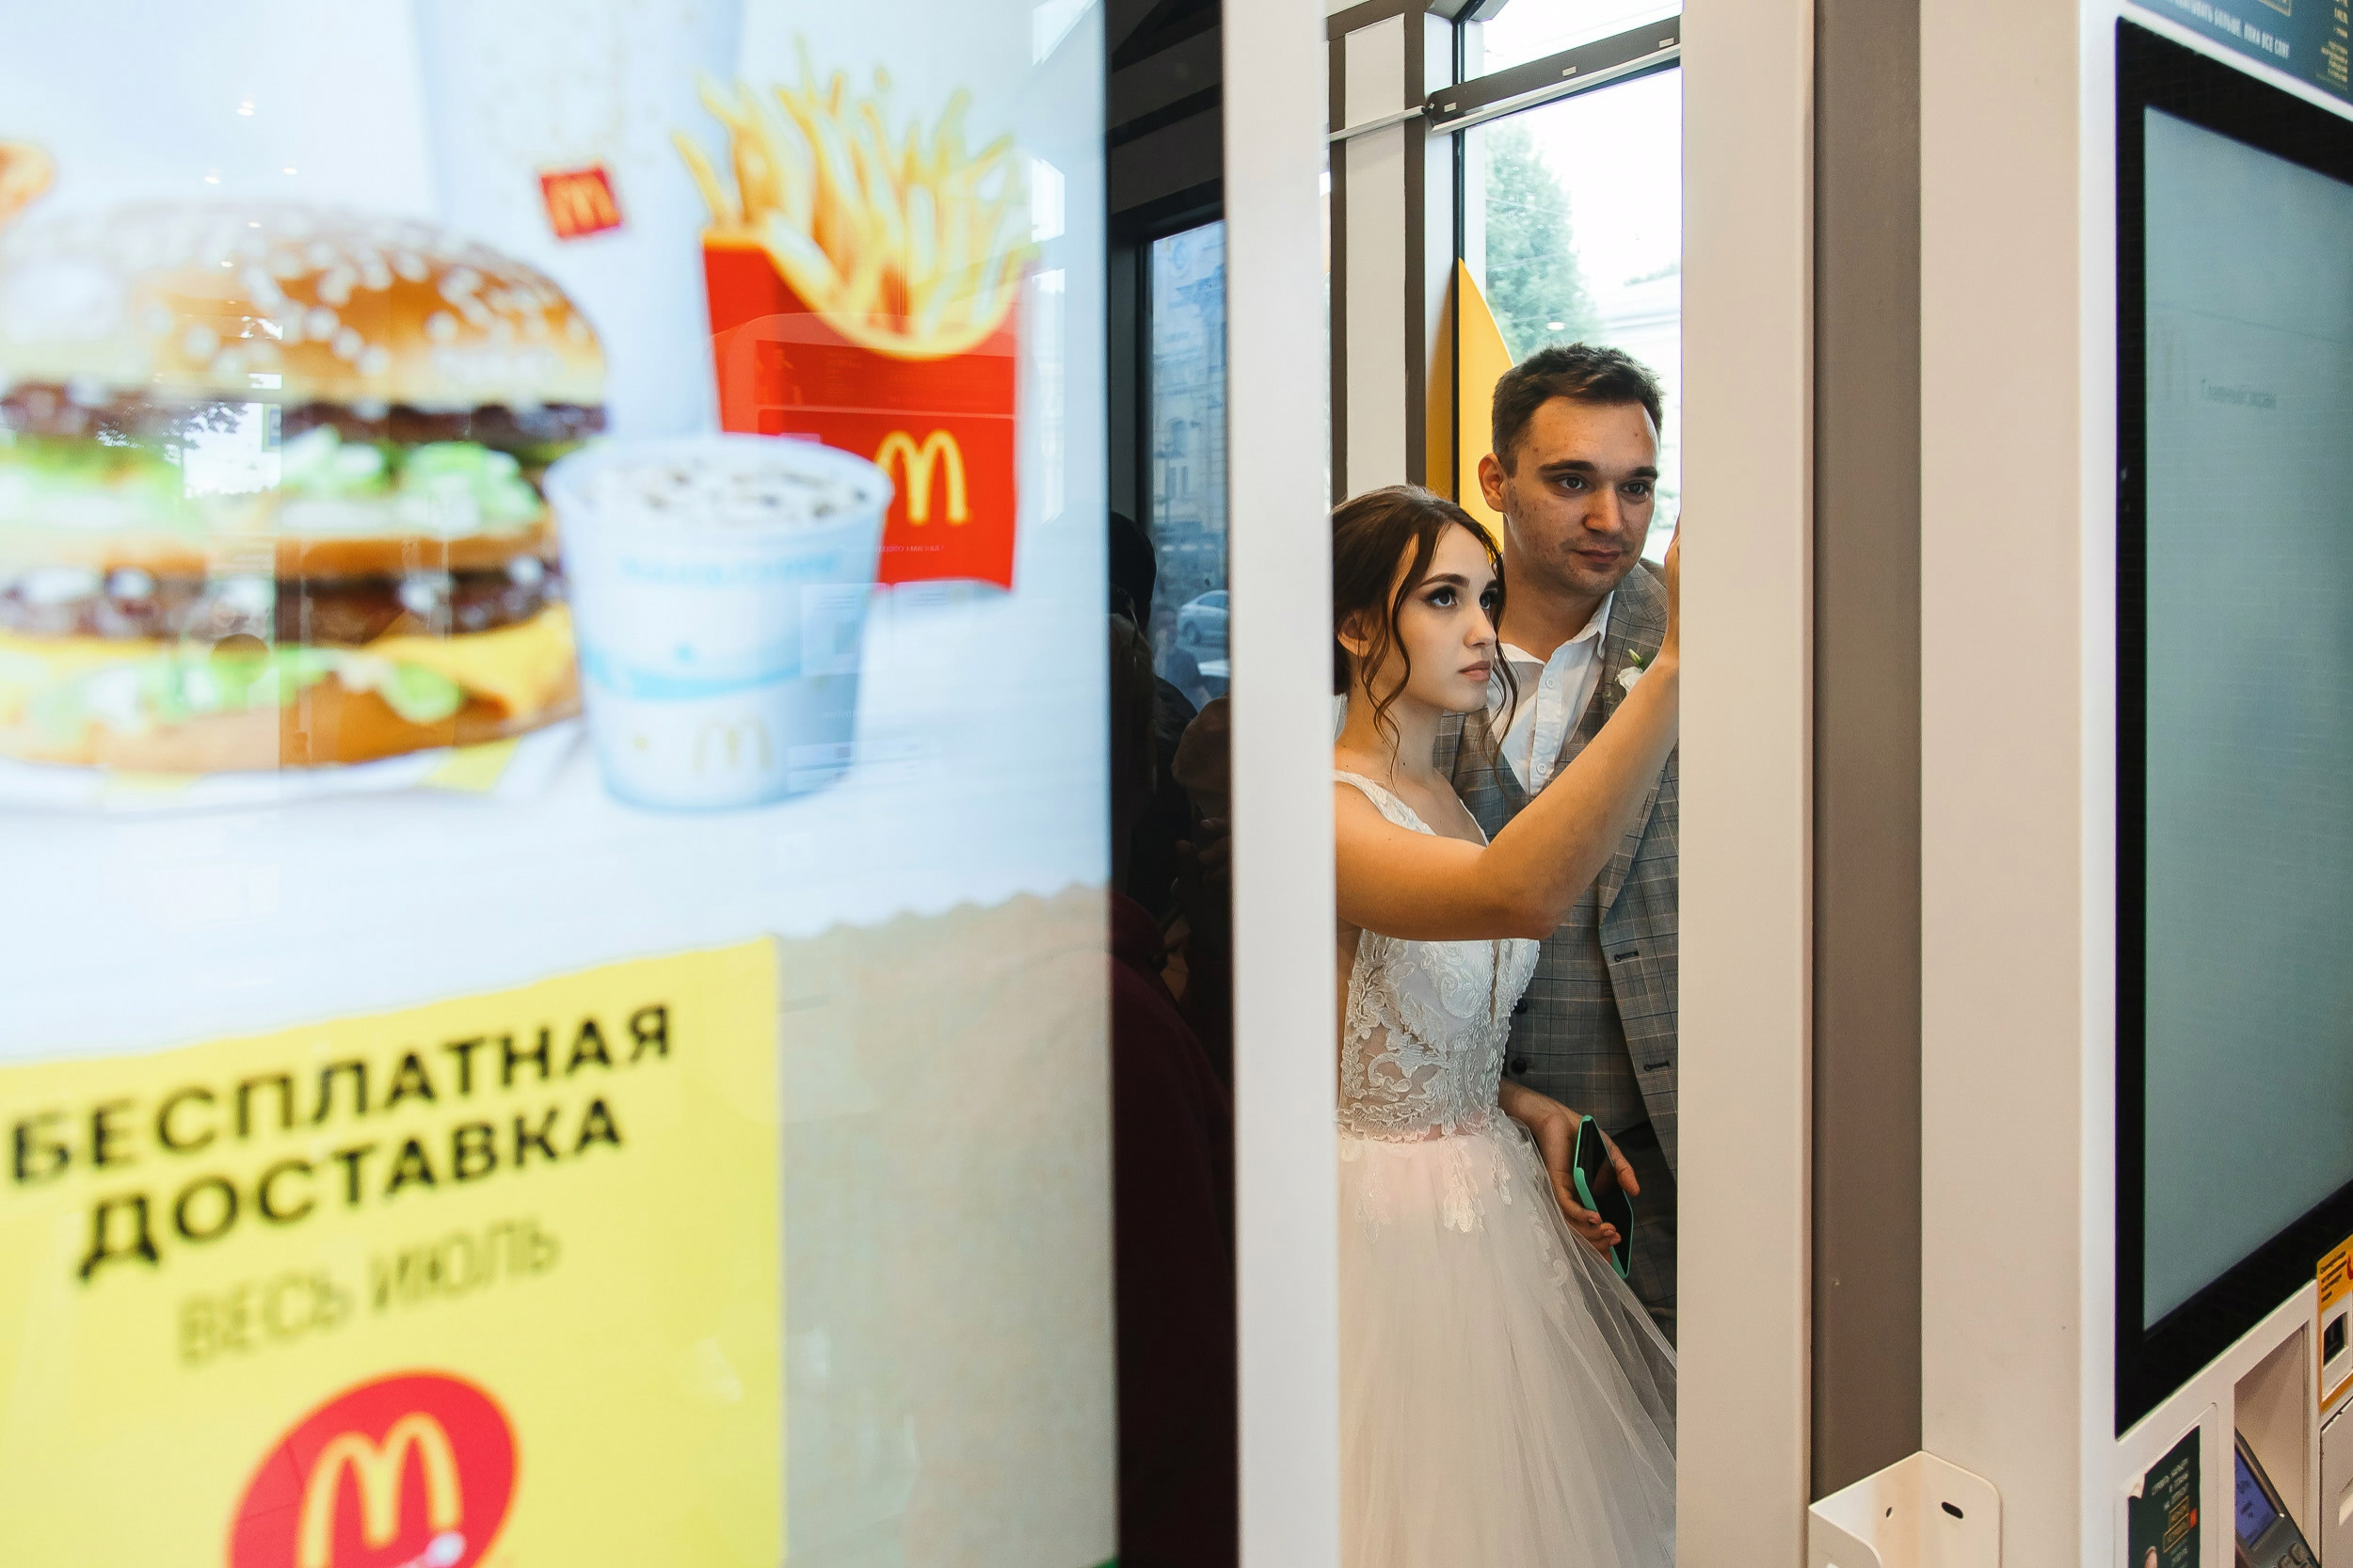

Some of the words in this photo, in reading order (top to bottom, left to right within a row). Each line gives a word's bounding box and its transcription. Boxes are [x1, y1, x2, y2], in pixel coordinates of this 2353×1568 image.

[11, 1003, 672, 1183] БЕСПЛАТНАЯ
[79, 1097, 625, 1283] ДОСТАВКА
[178, 1272, 352, 1366] ВЕСЬ
[370, 1218, 561, 1312] ИЮЛЬ
